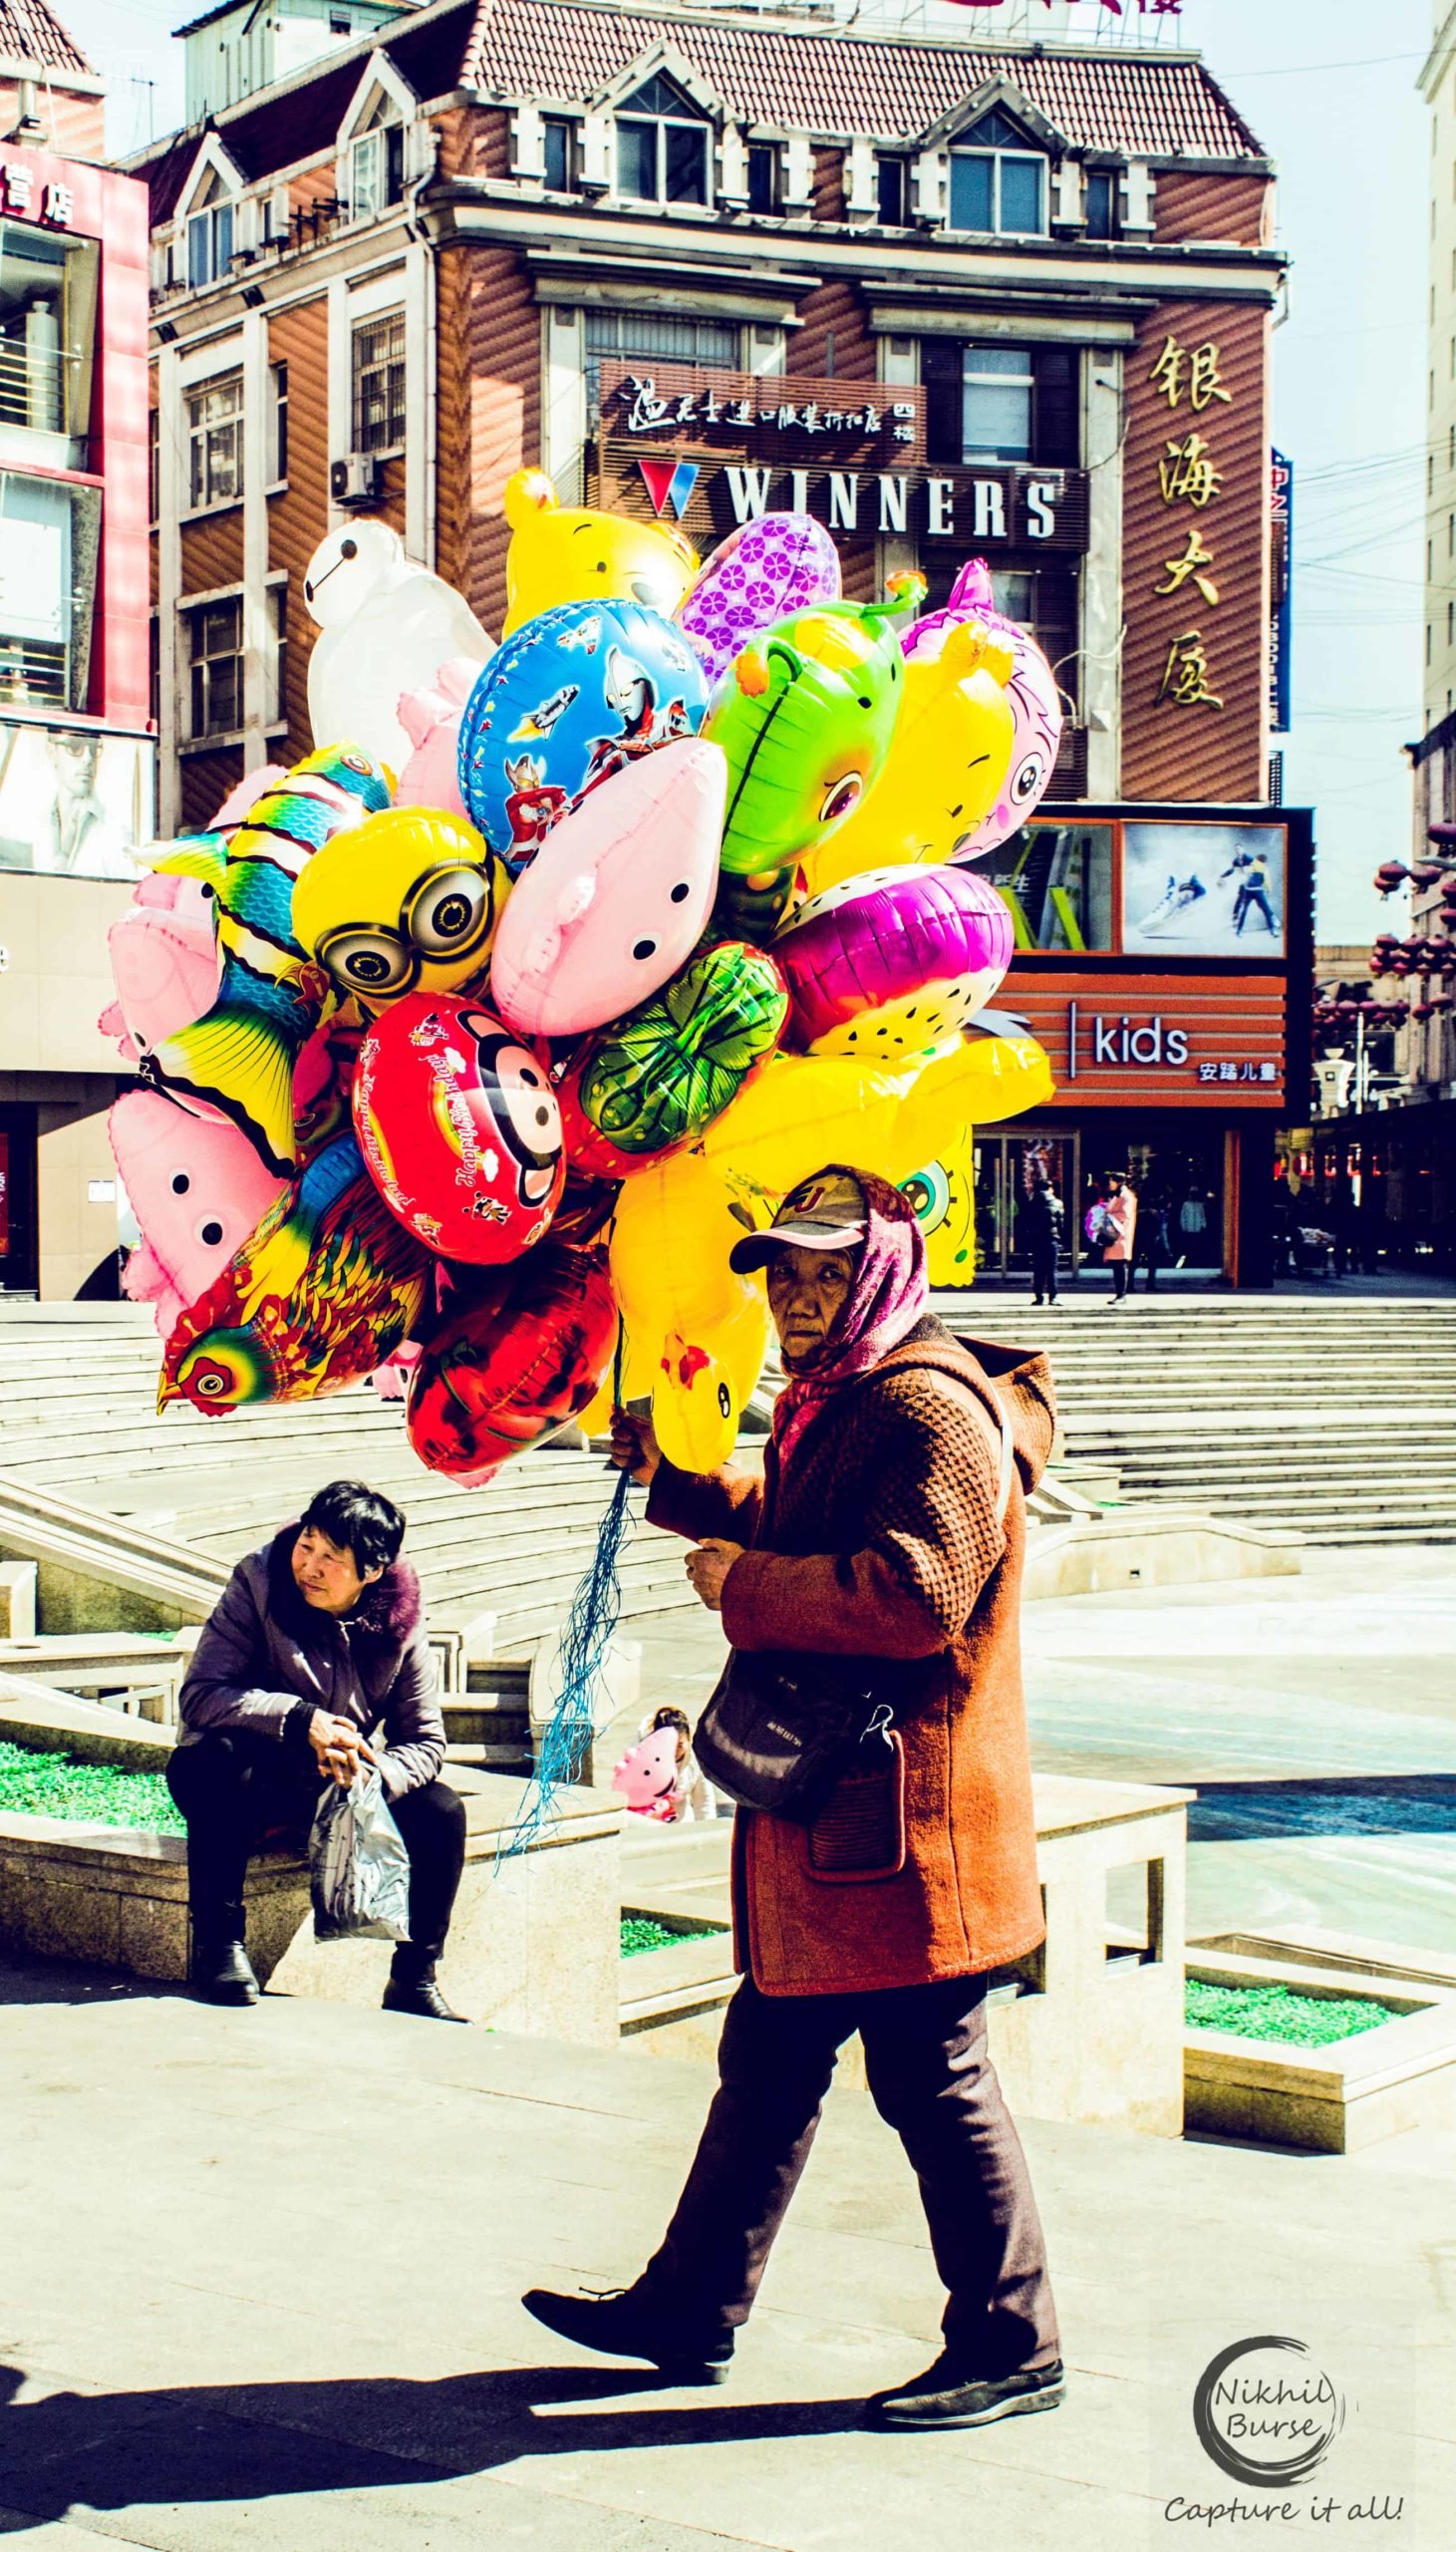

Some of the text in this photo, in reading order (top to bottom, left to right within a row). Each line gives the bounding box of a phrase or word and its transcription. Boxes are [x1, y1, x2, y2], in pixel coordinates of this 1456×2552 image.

[724, 466, 1055, 539] WINNERS
[1096, 1017, 1189, 1065] kids
[1200, 1062, 1278, 1082] 安踏儿童
